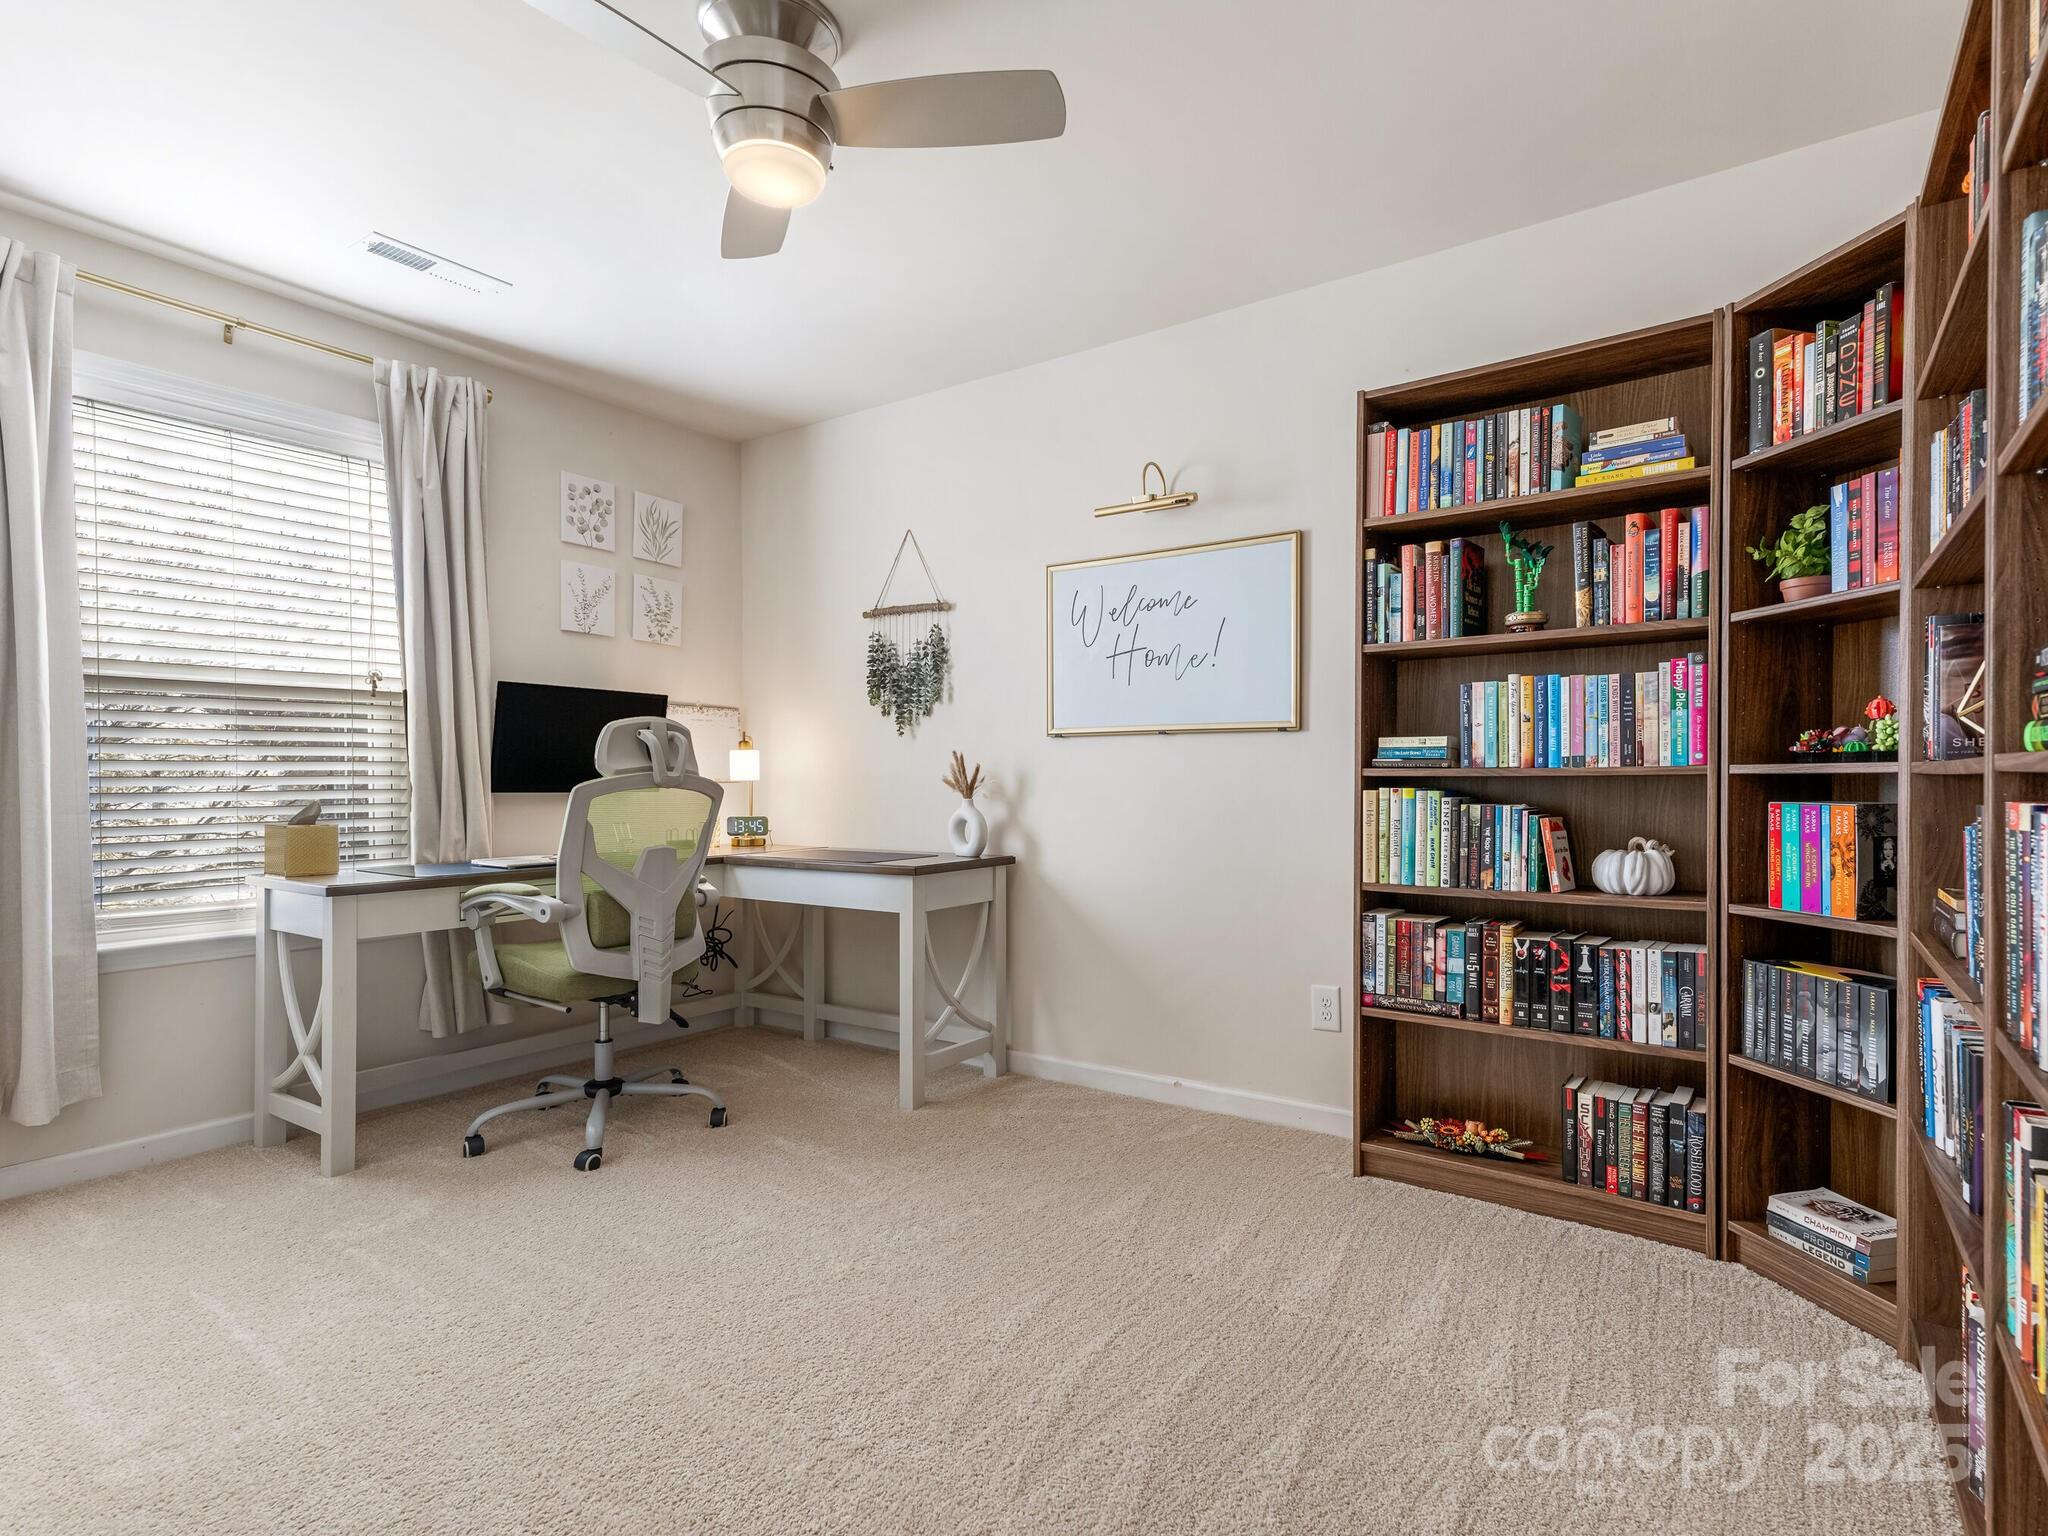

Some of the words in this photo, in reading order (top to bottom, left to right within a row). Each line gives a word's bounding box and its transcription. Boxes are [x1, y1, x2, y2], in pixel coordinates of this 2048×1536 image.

[1781, 363, 1789, 425] ILLUMINAE
[1884, 485, 1892, 499] True
[1884, 500, 1892, 519] Colors
[1071, 584, 1198, 648] Welcome
[1106, 617, 1226, 686] Home!
[1673, 660, 1686, 692] Happy
[1676, 692, 1686, 717] Place
[1600, 717, 1607, 725] US
[1612, 714, 1619, 722] US
[734, 819, 764, 833] 13:45
[1442, 800, 1450, 833] BINGE
[1393, 819, 1401, 857] Educated
[1469, 952, 1478, 964] THE
[1505, 942, 1513, 964] HARRY
[1468, 972, 1478, 989] WAVE
[1505, 966, 1513, 992] POTTER
[1783, 1014, 1792, 1030] HEIR
[1783, 1033, 1792, 1042] OF
[1783, 1044, 1792, 1061] FIRE
[1632, 1120, 1645, 1134] THE
[1632, 1135, 1645, 1156] FINAL
[1632, 1159, 1645, 1186] GAMBIT
[1803, 1215, 1852, 1243] CHAMPION
[1801, 1242, 1846, 1270] LEGEND
[1802, 1231, 1852, 1260] PRODIGY
